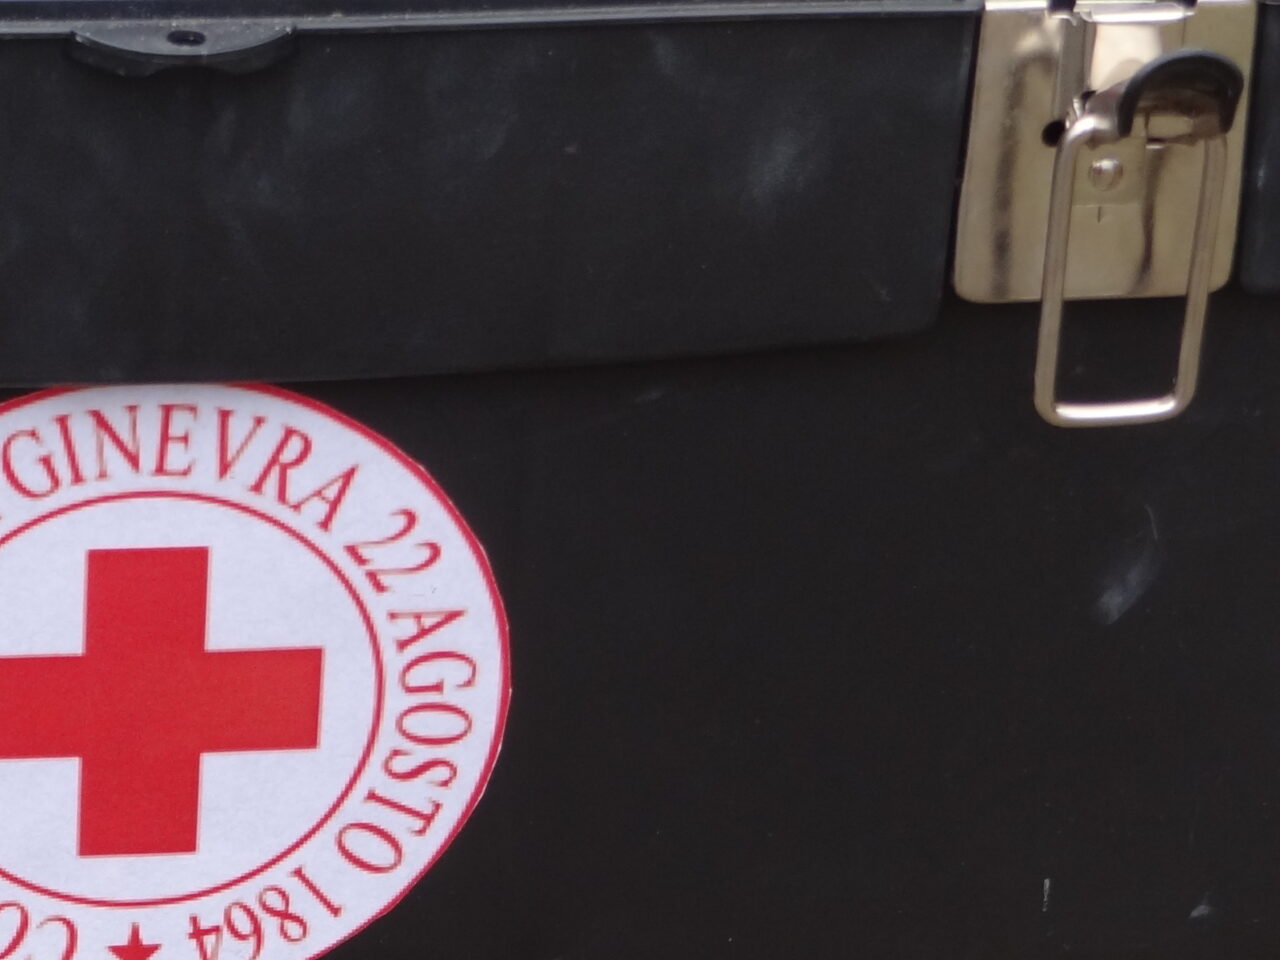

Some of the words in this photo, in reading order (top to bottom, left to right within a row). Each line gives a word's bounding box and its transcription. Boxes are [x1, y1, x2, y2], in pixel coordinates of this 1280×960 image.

[1, 403, 360, 533] GINEVRA
[344, 507, 442, 594] 22
[336, 608, 477, 875] AGOSTO
